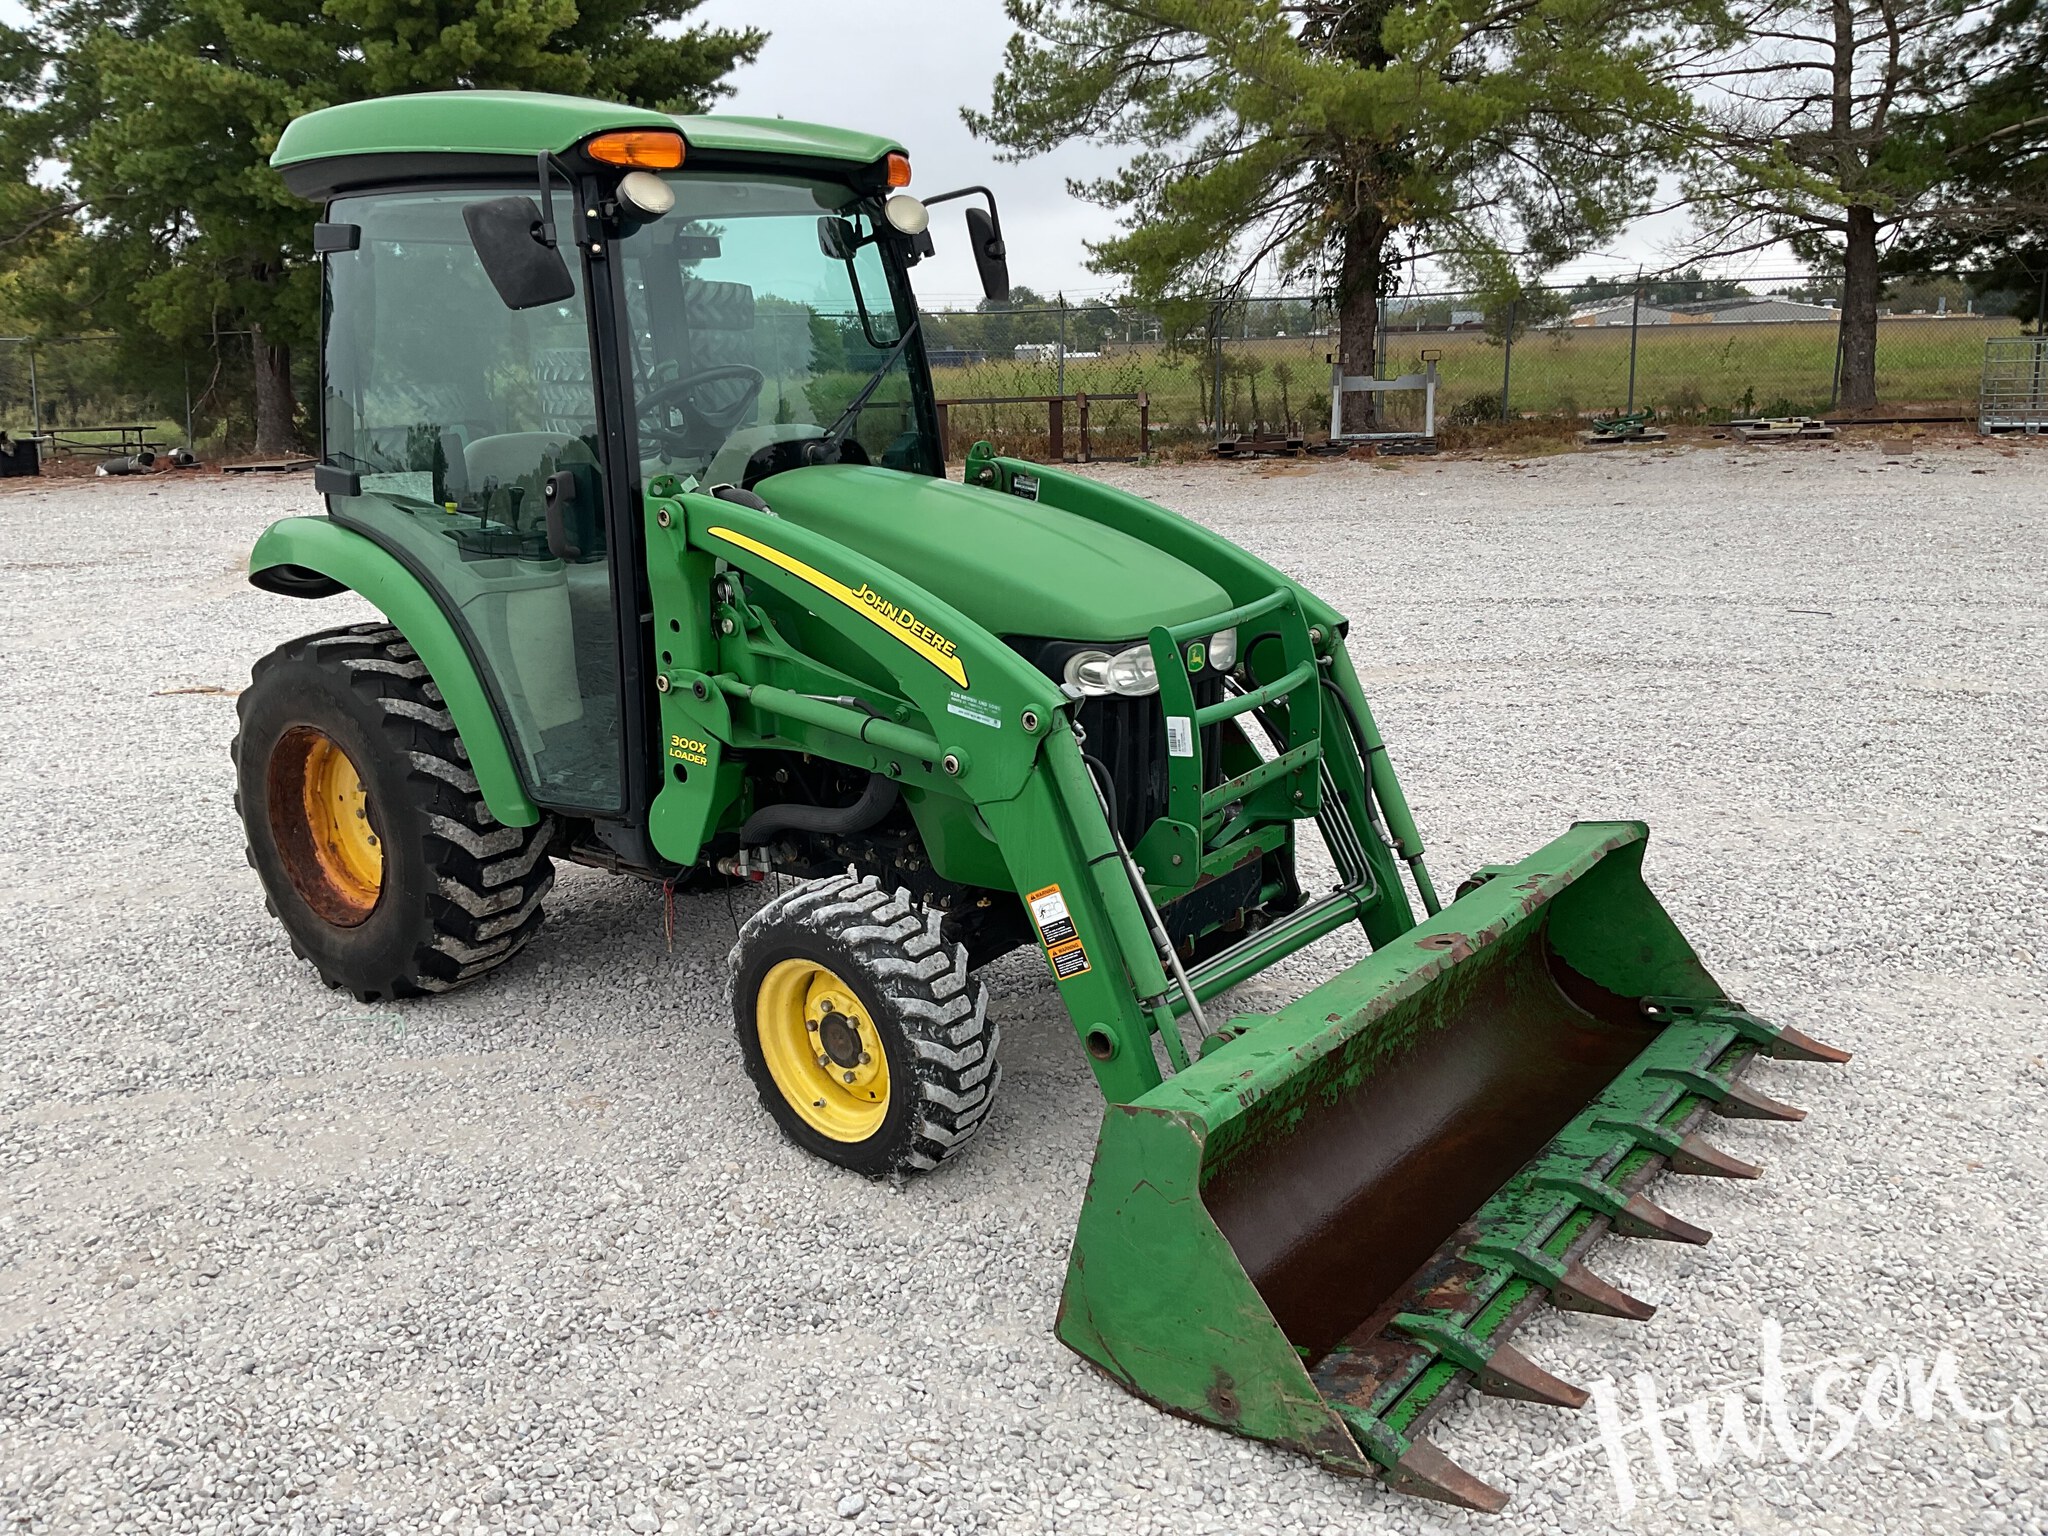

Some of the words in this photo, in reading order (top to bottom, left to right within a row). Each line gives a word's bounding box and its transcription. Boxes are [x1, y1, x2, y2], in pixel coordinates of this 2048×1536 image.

[851, 583, 900, 622] JOHN
[896, 608, 957, 658] DEERE
[671, 734, 707, 754] 300X
[669, 747, 708, 766] LOADER
[1035, 886, 1056, 899] WARNING
[1057, 942, 1079, 954] WARNING
